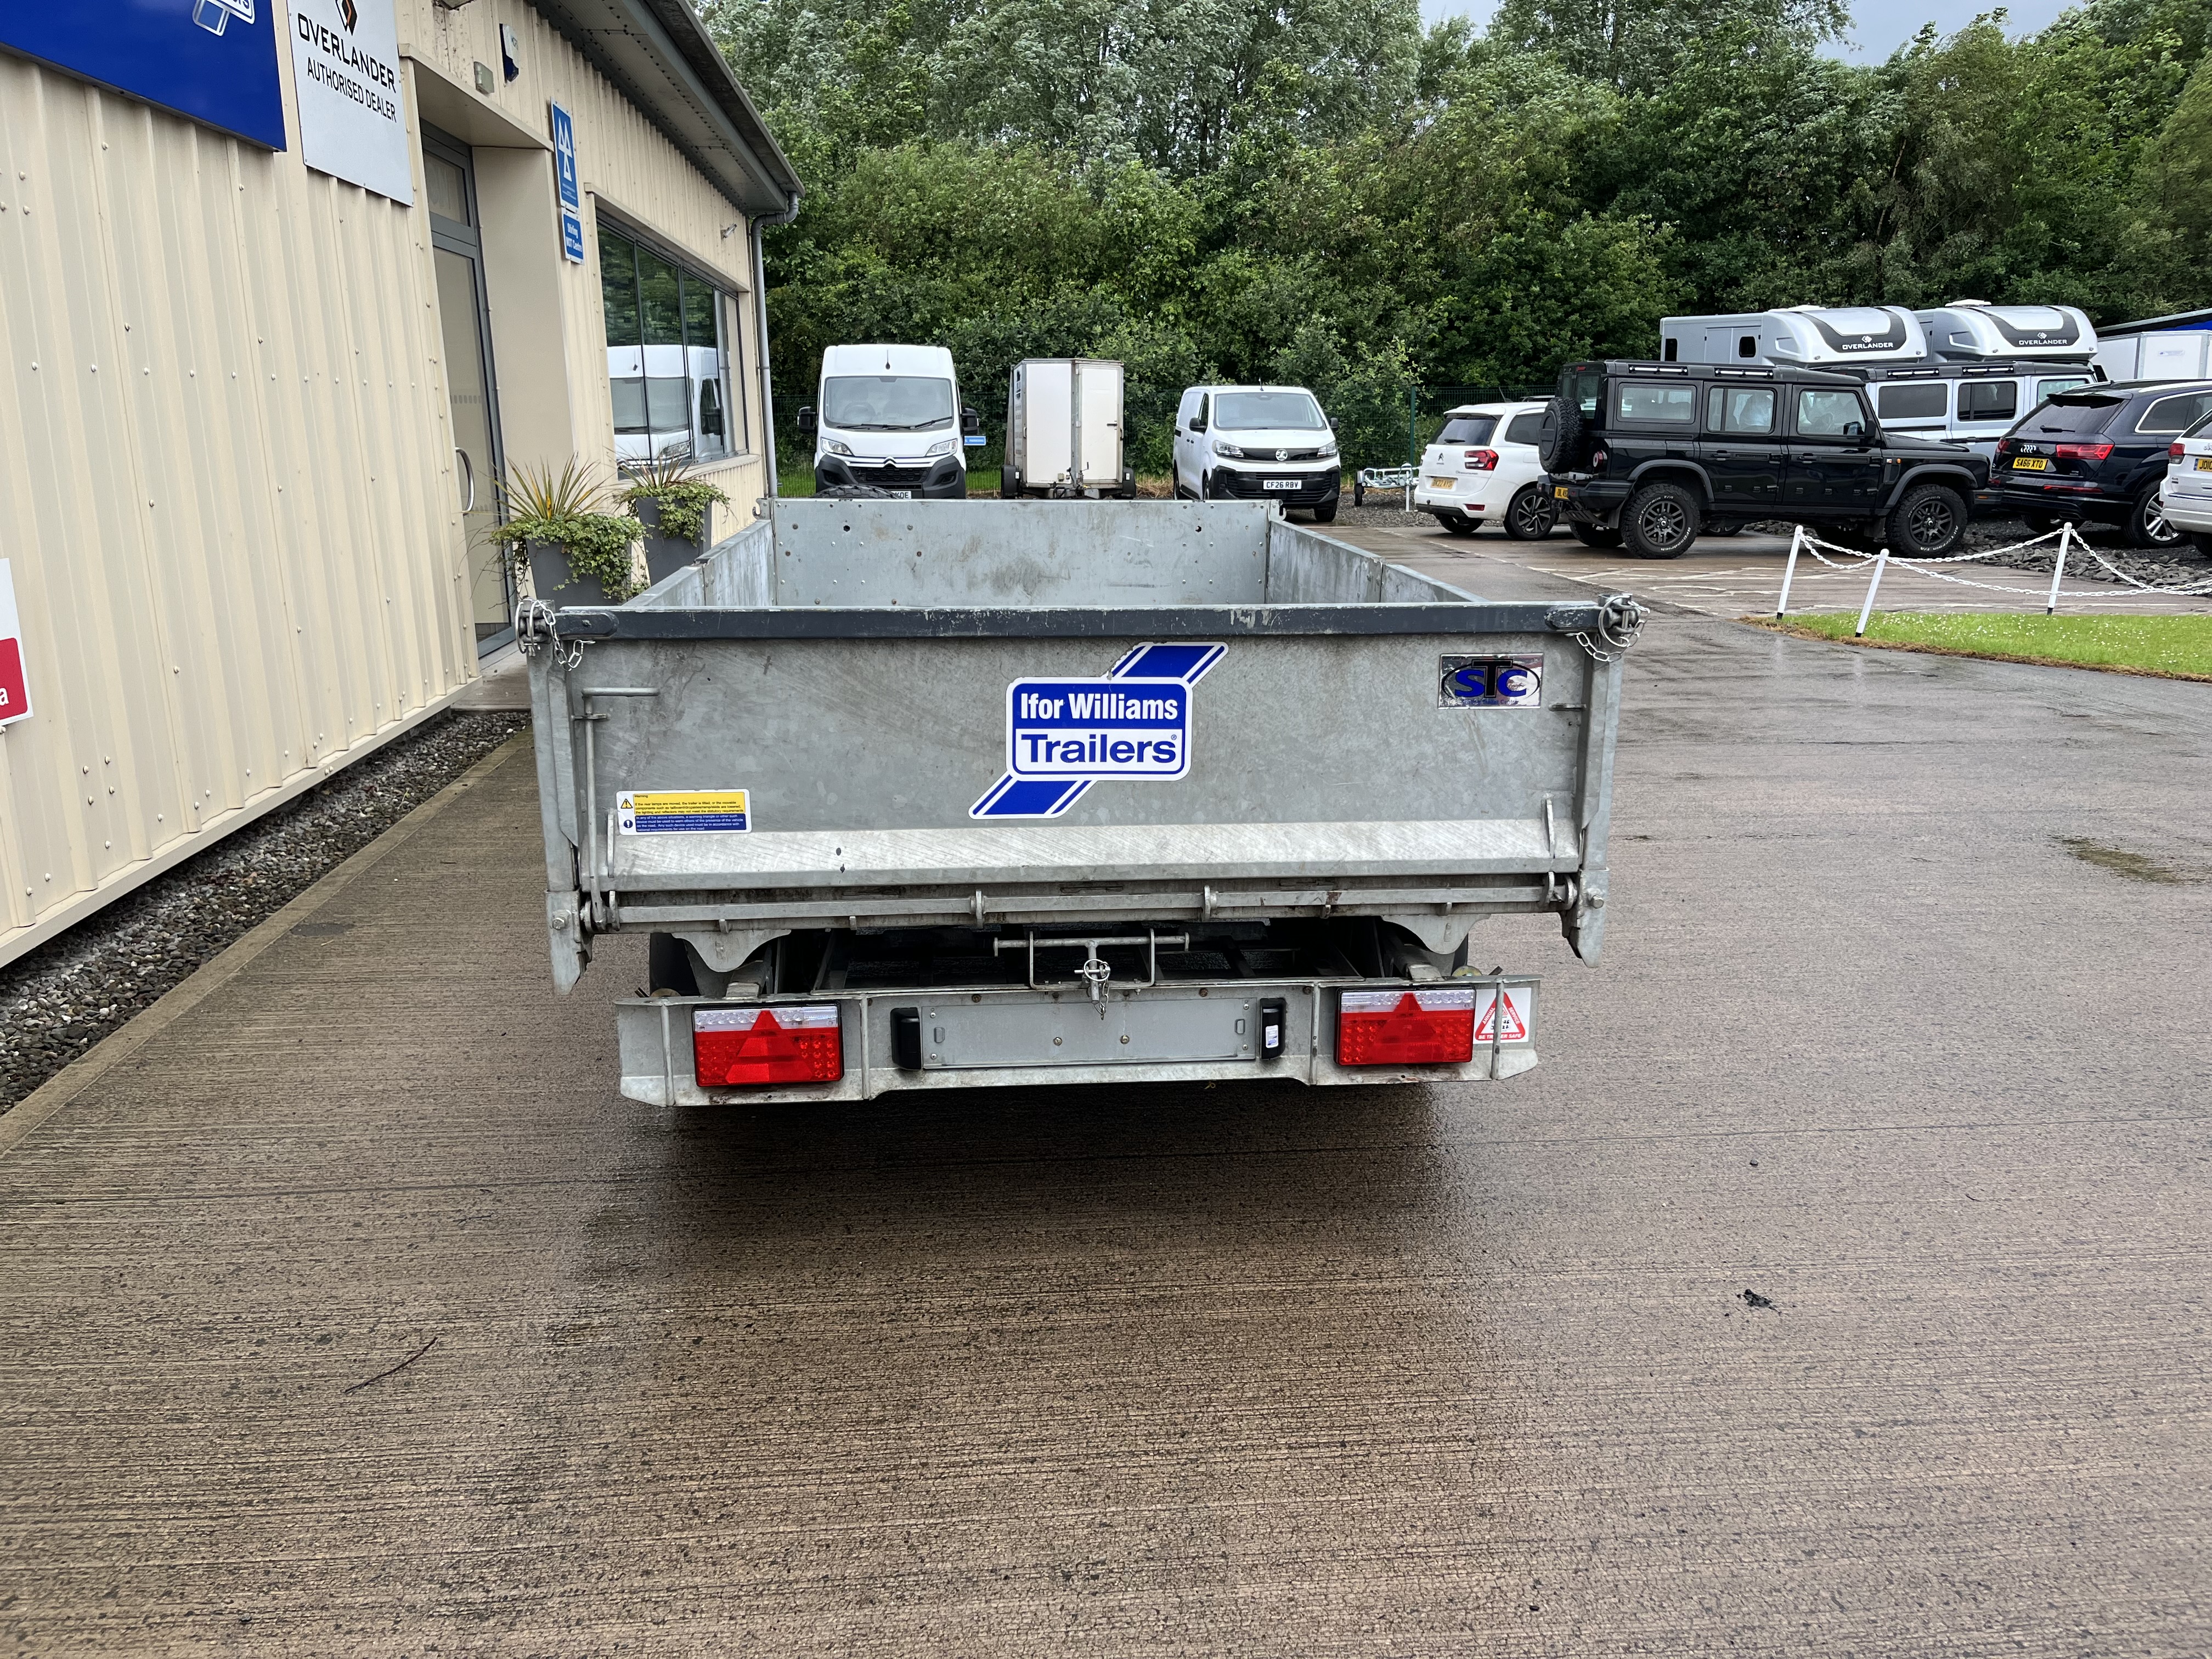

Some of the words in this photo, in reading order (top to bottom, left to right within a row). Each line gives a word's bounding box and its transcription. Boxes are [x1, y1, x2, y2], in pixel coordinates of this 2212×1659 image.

[297, 12, 397, 94] OVERLANDER
[307, 57, 364, 105] AUTHORISED
[365, 88, 397, 123] DEALER
[1454, 658, 1528, 698] STC
[1021, 693, 1064, 719] Ifor
[1068, 693, 1178, 719] Williams
[1482, 1007, 1496, 1025] ANNUAL
[1508, 1007, 1521, 1024] SERVICE
